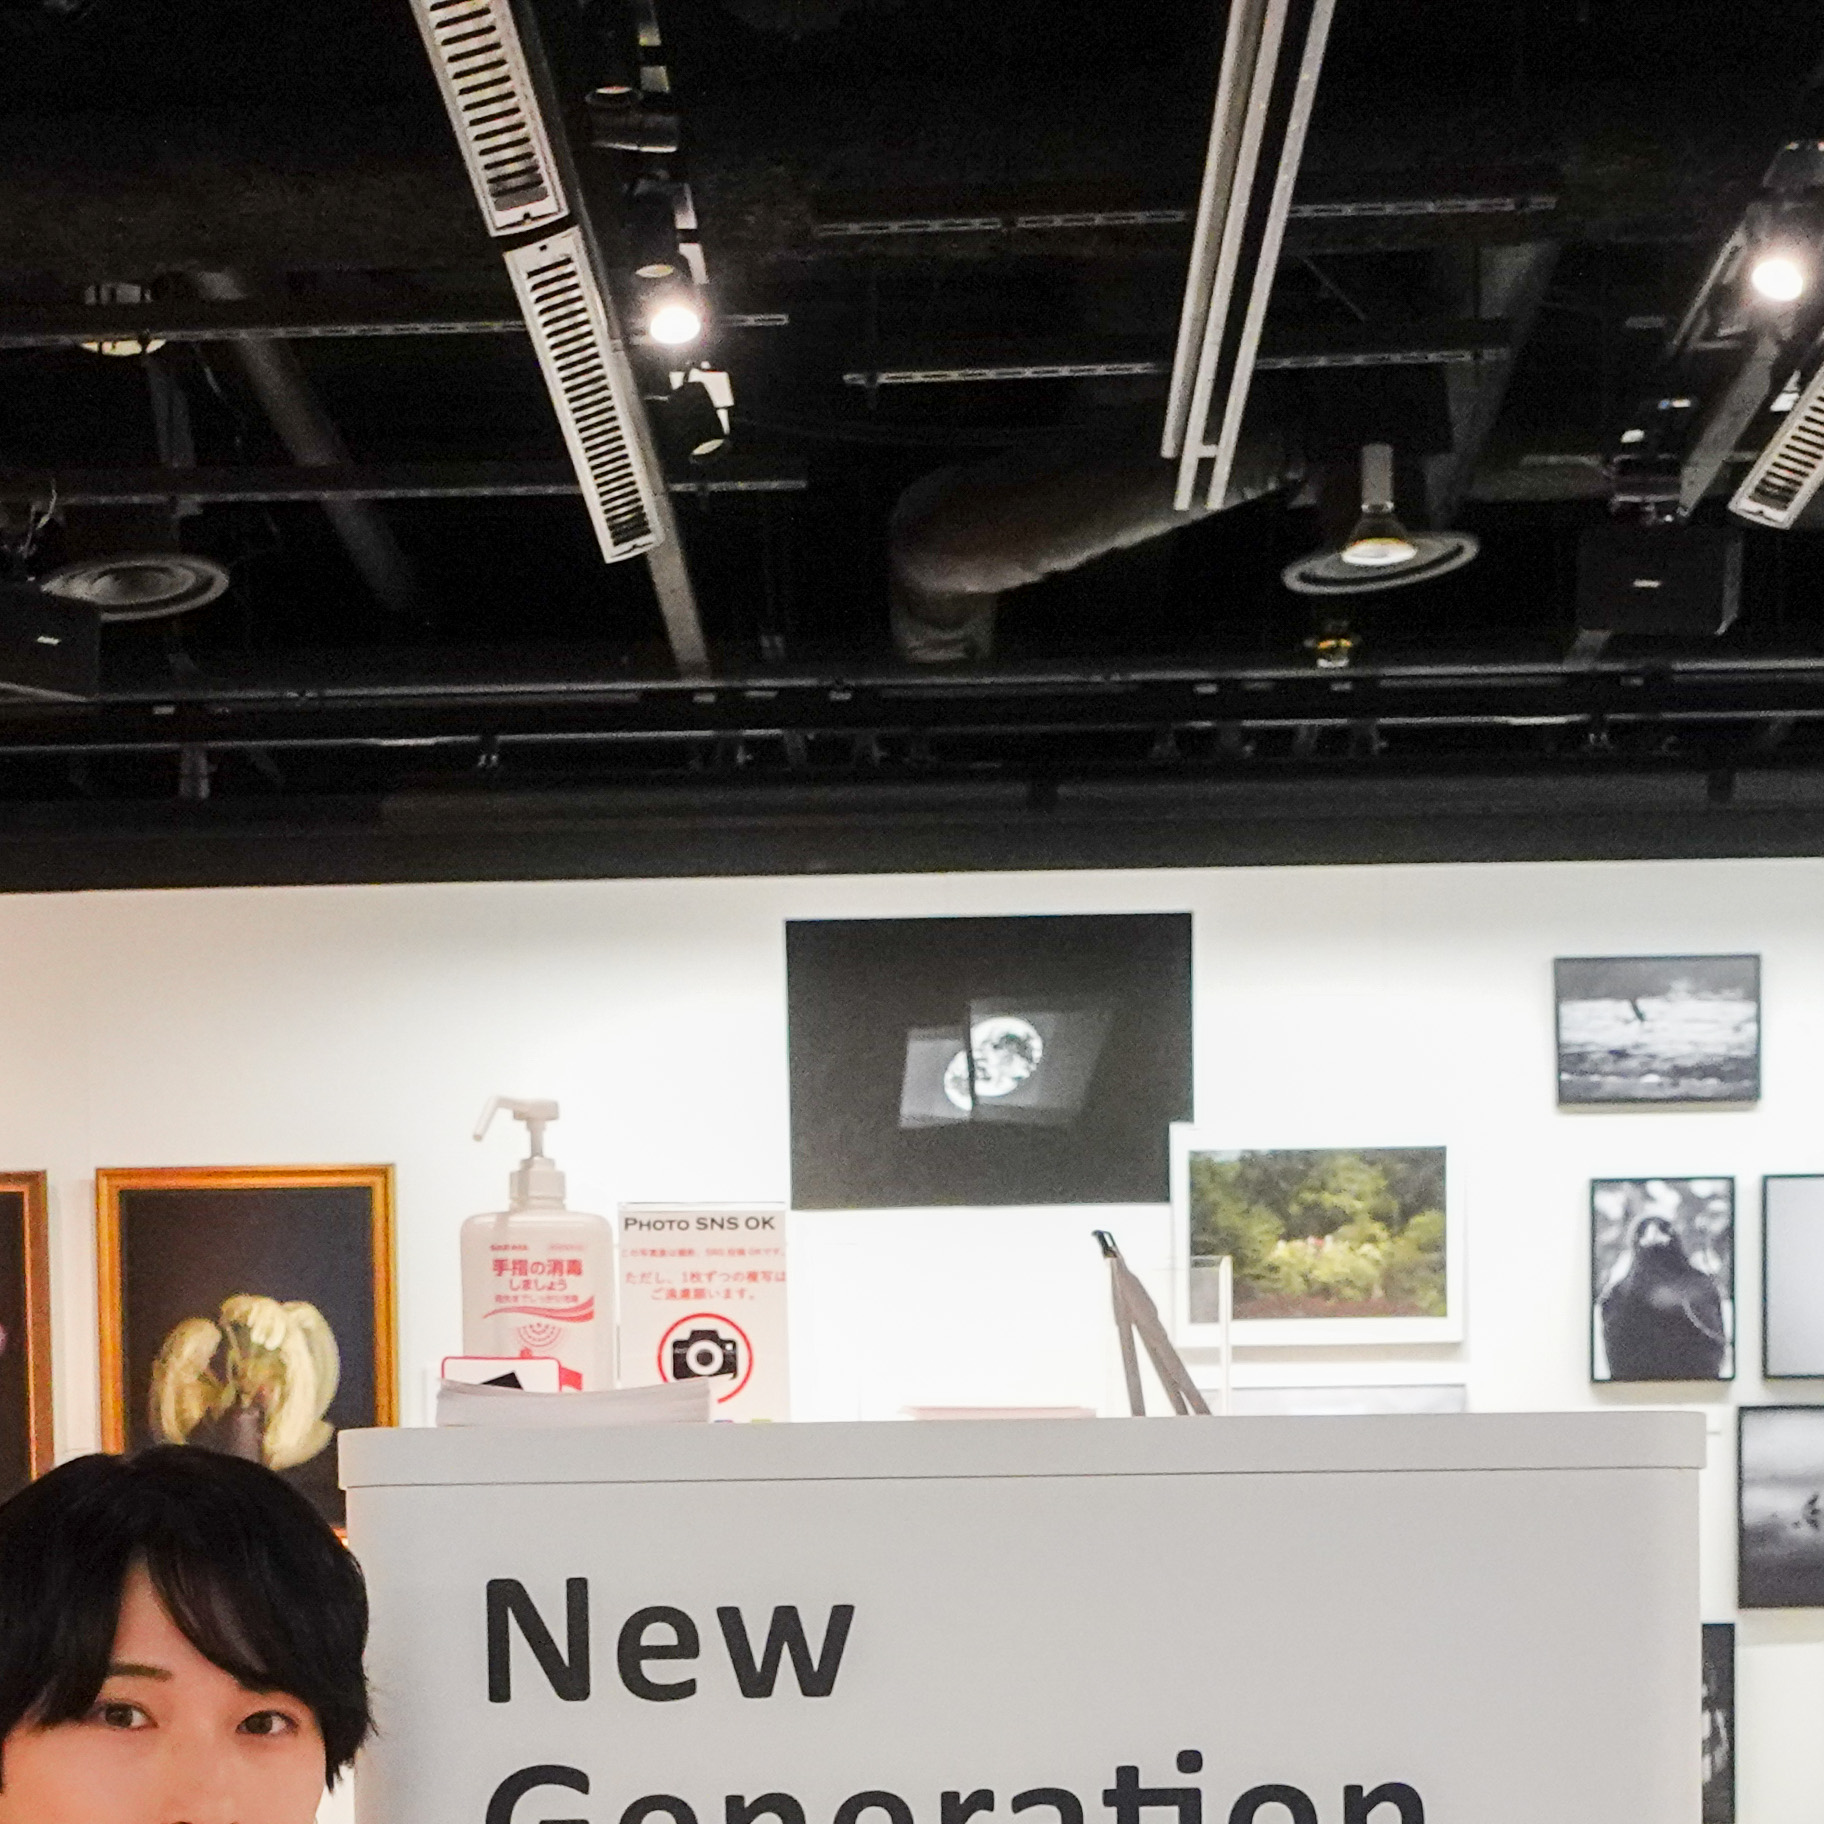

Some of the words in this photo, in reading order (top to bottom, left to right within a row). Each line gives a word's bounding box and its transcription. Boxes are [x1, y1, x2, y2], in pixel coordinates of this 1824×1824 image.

[624, 1217, 690, 1231] PHOTO
[696, 1217, 740, 1231] SNS
[744, 1216, 776, 1231] OK
[493, 1259, 583, 1276] 手指の消毒
[509, 1279, 567, 1291] しましょう
[486, 1577, 856, 1705] New
